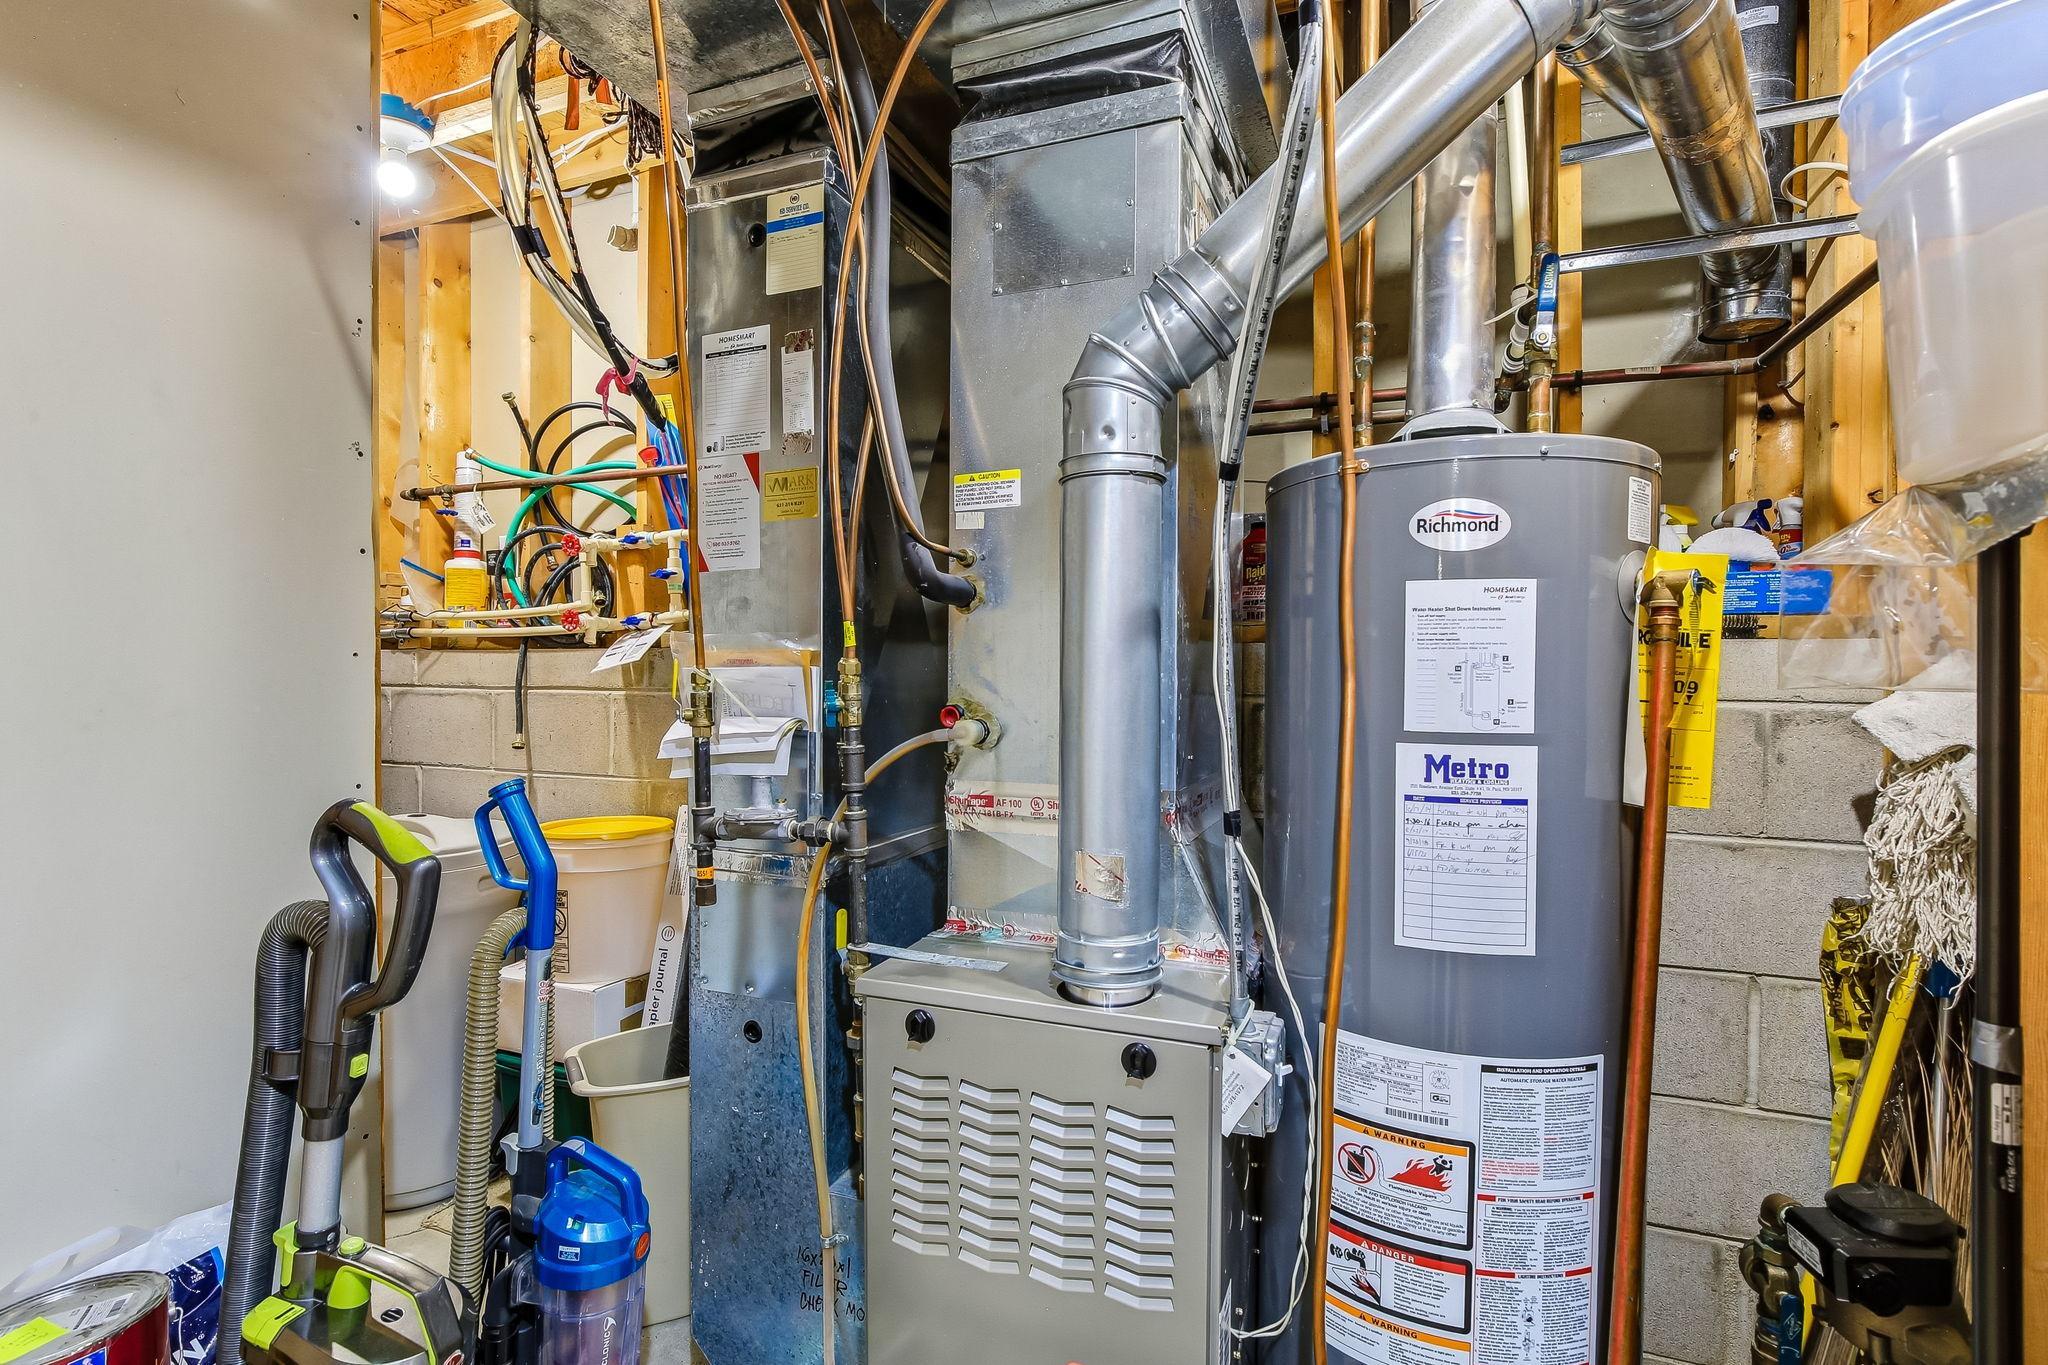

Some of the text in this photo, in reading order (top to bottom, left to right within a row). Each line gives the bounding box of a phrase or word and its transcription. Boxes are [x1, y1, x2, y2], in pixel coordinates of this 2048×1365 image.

[718, 332, 755, 344] HOMESMART
[1417, 515, 1499, 533] Richmond
[1424, 754, 1509, 783] Metro
[1009, 800, 1021, 808] 100
[656, 948, 669, 993] journal
[1374, 1130, 1426, 1149] WARNING
[1388, 1184, 1437, 1199] Flammable Vapors
[1372, 1244, 1415, 1263] DANGER
[1371, 1318, 1418, 1338] WARNING
